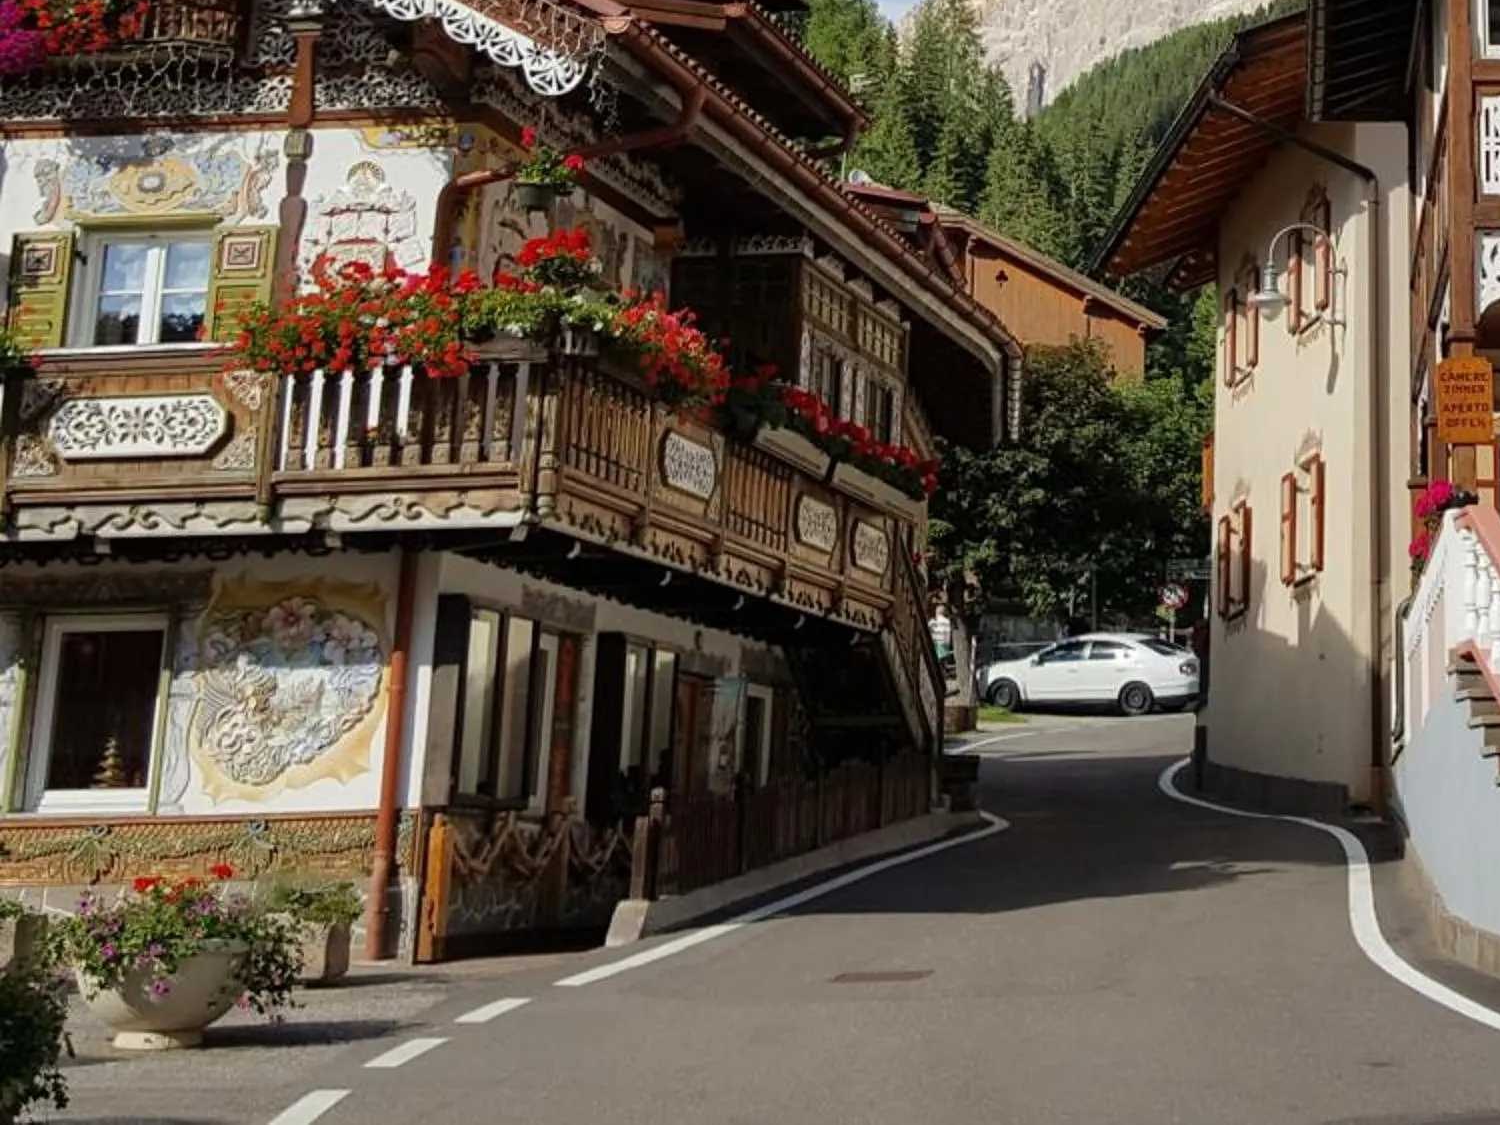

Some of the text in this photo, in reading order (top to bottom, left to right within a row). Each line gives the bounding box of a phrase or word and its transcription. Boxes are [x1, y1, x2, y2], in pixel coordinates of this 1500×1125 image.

[1439, 371, 1488, 382] CAMERE
[1443, 384, 1485, 394] ZIMMER
[1443, 402, 1489, 413] APERTO
[1446, 418, 1487, 428] OFFEN
